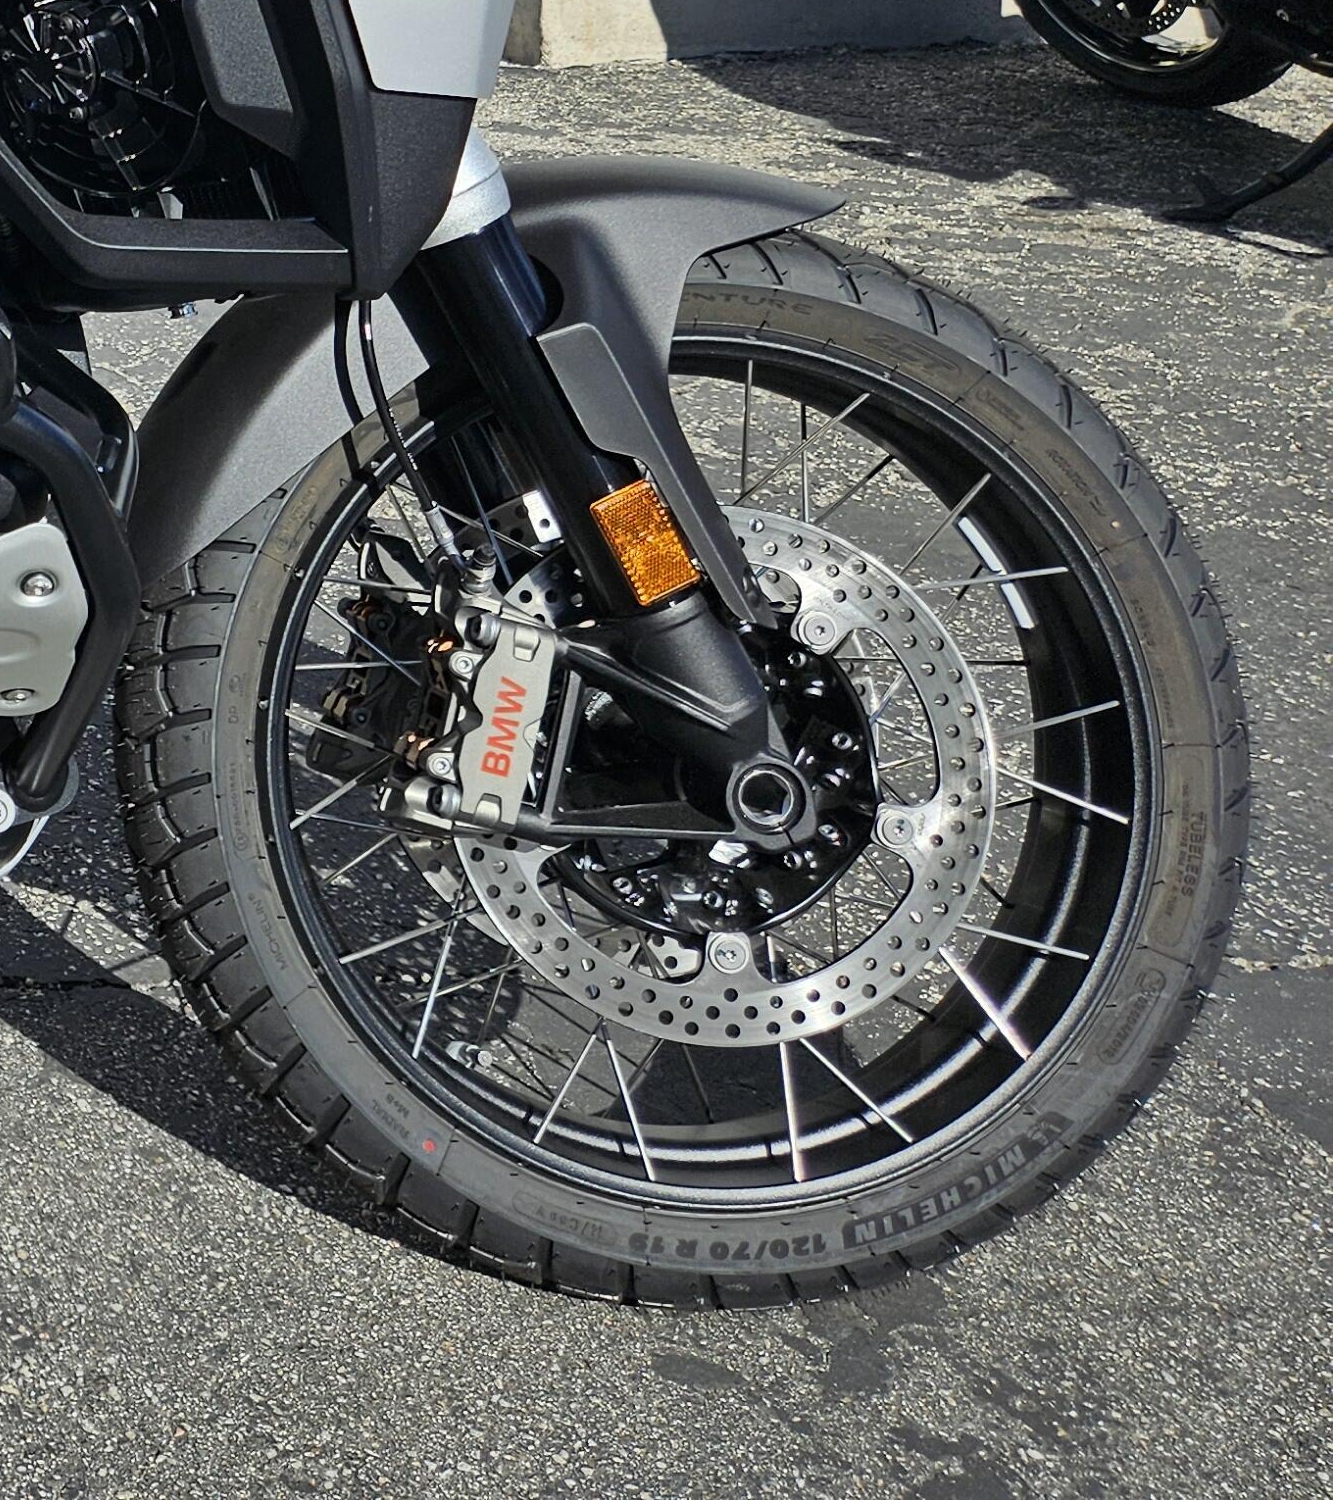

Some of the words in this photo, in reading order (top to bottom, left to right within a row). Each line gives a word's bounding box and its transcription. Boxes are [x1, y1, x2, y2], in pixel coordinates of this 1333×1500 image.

[683, 290, 813, 316] NTURE
[480, 675, 529, 779] BMW
[1179, 811, 1206, 897] TUBELESS
[849, 1142, 1031, 1245] MICHELIN
[627, 1231, 664, 1254] 19
[674, 1238, 697, 1258] R
[708, 1231, 827, 1261] 120/70
